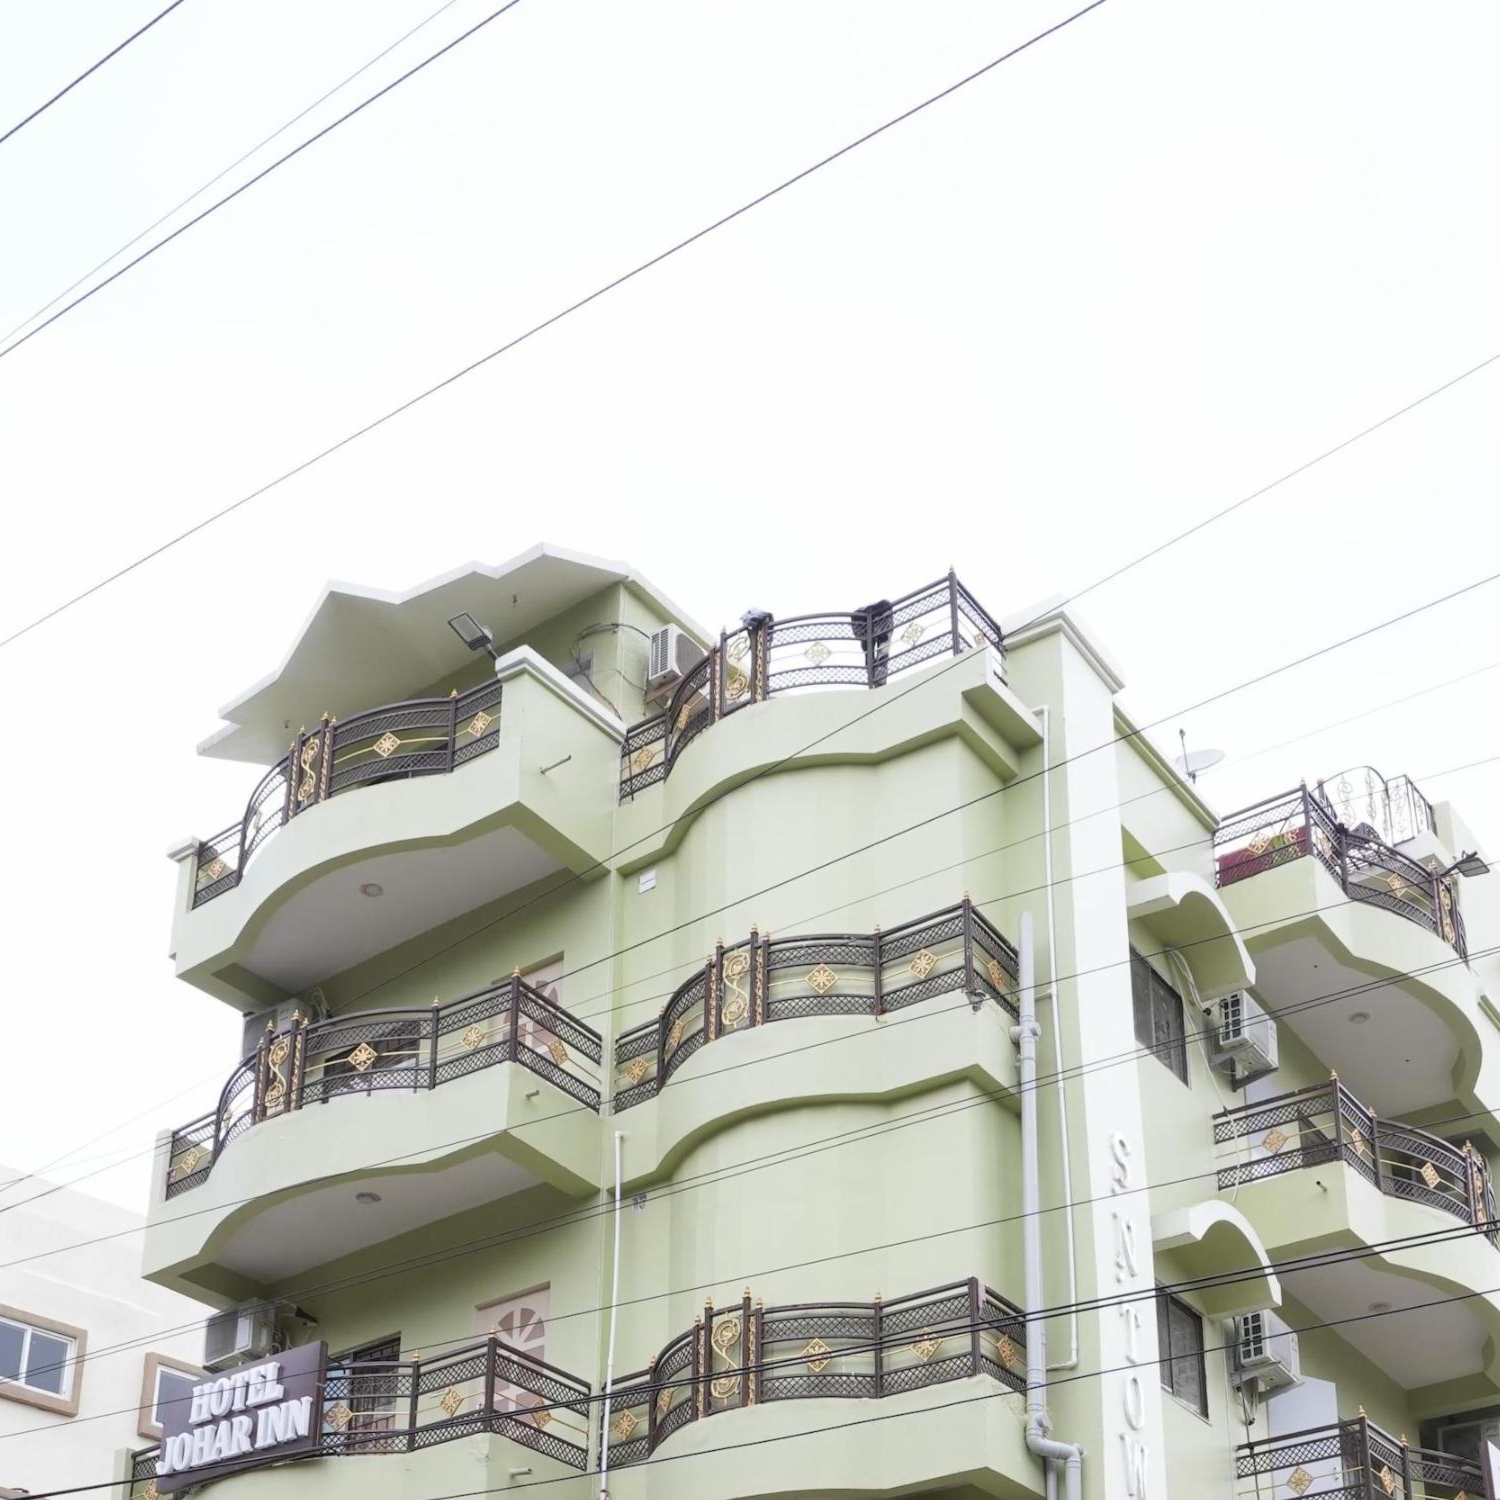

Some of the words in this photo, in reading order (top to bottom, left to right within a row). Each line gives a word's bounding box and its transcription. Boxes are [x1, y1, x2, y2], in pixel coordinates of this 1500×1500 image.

[189, 1361, 285, 1426] HOTEL
[155, 1414, 254, 1476] JOHAR
[255, 1396, 314, 1450] INN
